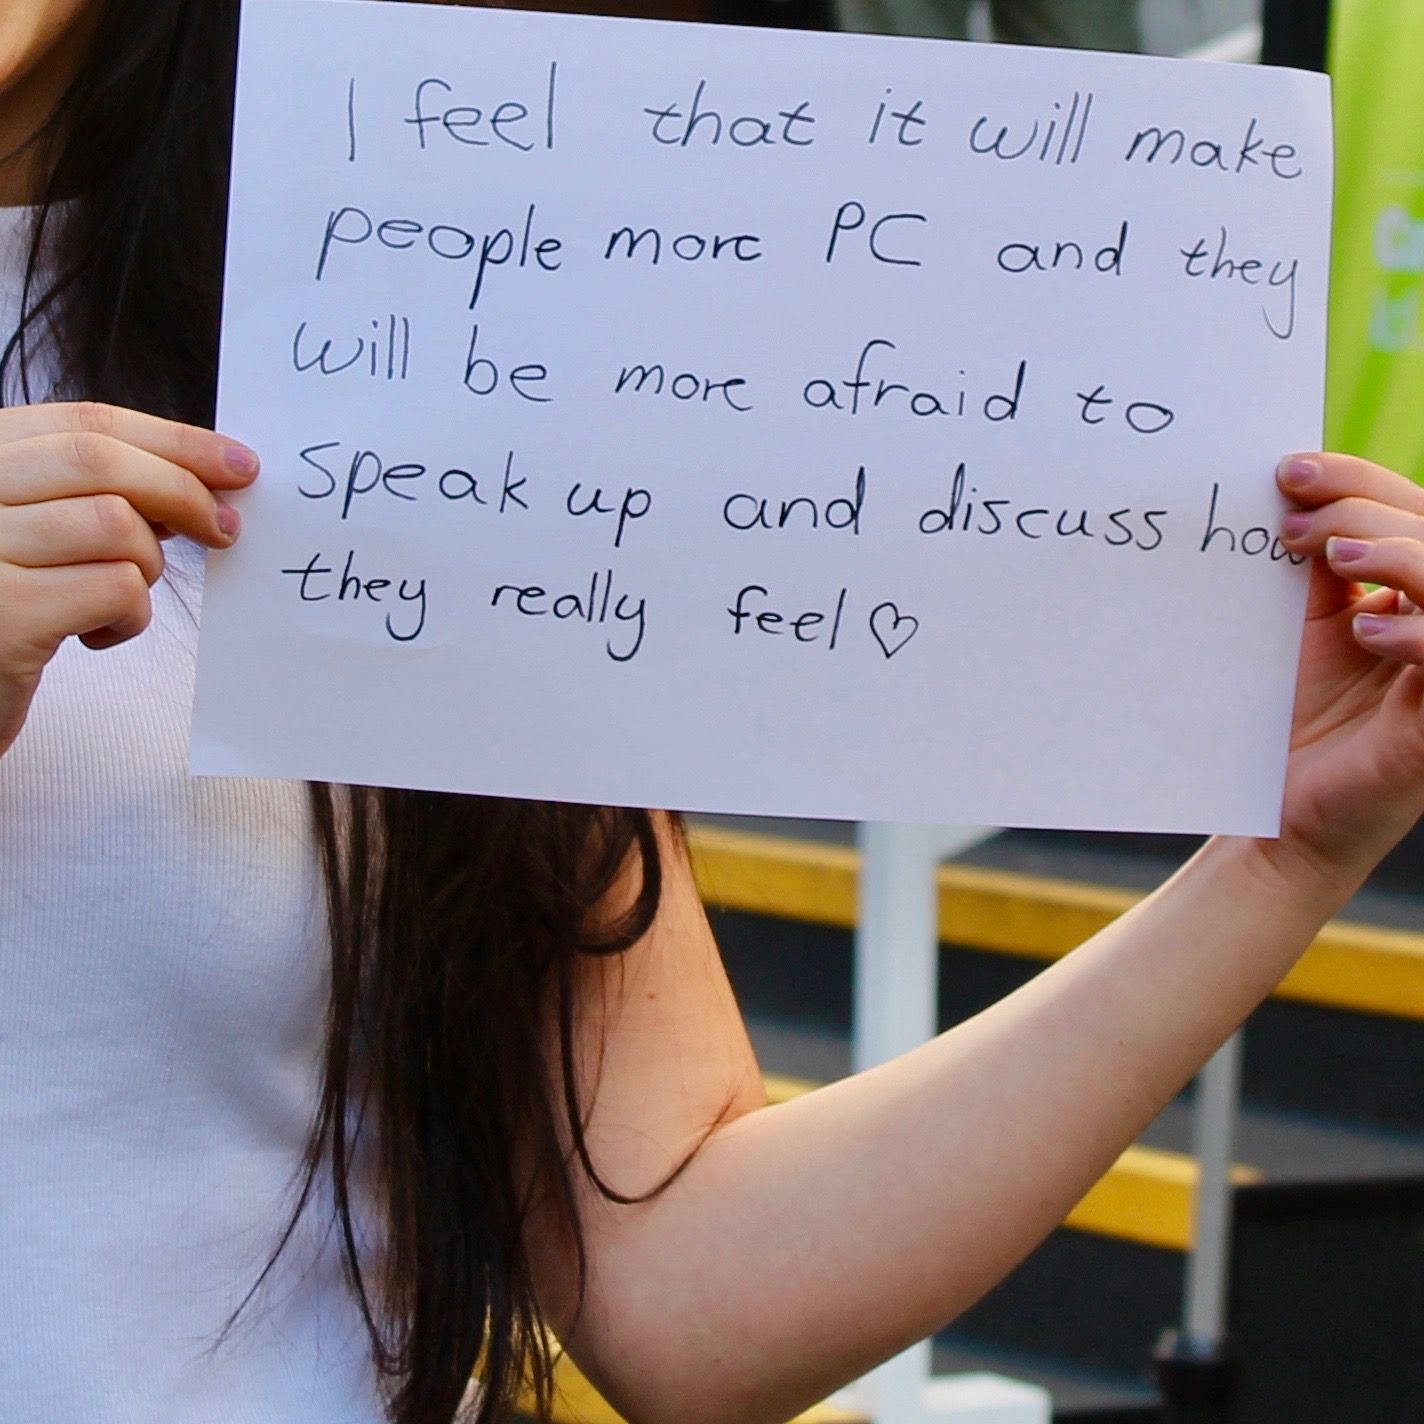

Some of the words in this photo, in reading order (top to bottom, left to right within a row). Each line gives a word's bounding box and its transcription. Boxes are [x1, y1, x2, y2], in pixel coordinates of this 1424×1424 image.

[347, 76, 357, 164] I
[403, 60, 557, 152] feel
[642, 79, 816, 148] that
[868, 88, 928, 147] it
[969, 91, 1094, 166] will
[1124, 117, 1303, 180] make
[315, 202, 563, 311] people
[603, 226, 764, 266] more
[825, 201, 929, 268] PC
[996, 220, 1129, 278] and
[1179, 226, 1299, 340] they
[463, 323, 554, 404] be
[614, 364, 754, 413] more
[802, 338, 1028, 423] afraid
[1074, 384, 1176, 434] to
[565, 481, 653, 549] up
[722, 465, 867, 536] and
[917, 461, 1168, 553] discuss
[279, 549, 428, 643] they
[490, 568, 647, 663] really
[726, 584, 844, 652] feel
